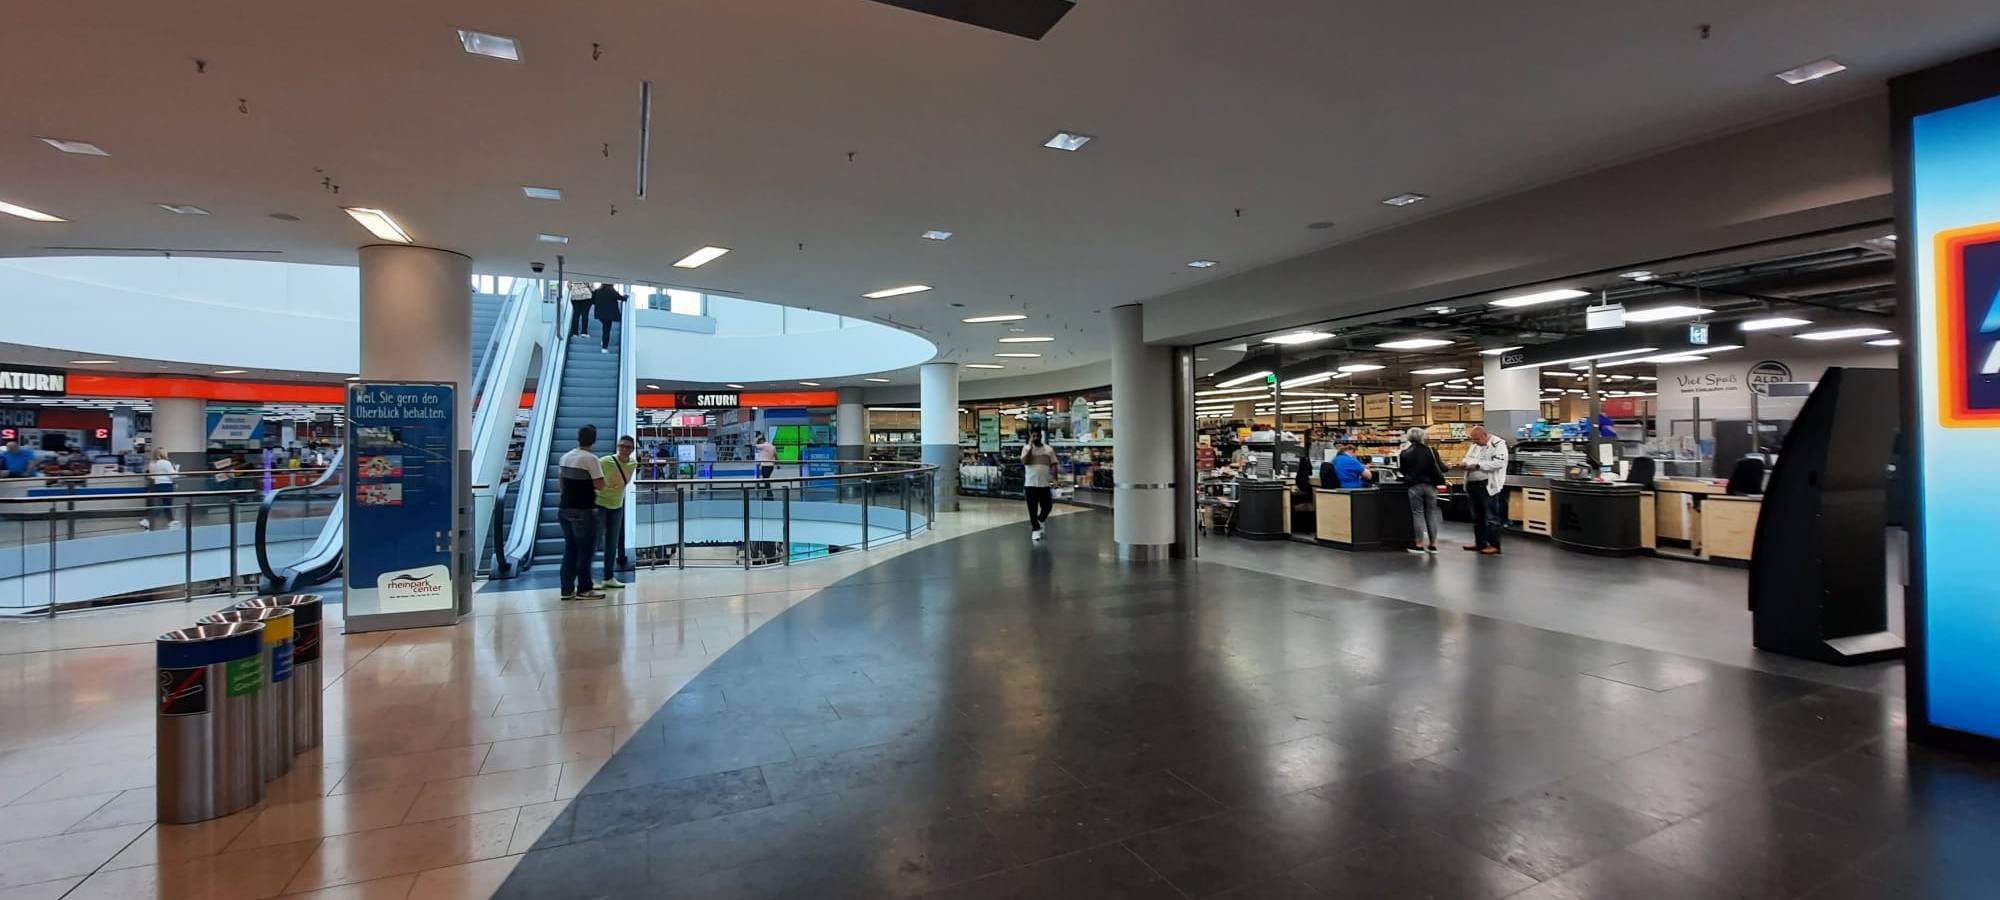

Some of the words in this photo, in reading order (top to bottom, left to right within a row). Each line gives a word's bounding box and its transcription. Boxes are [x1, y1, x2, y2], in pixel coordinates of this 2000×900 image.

[1677, 375, 1701, 387] Viel
[1754, 375, 1784, 383] ALDI
[356, 391, 376, 404] Weil
[379, 391, 394, 404] Sie
[397, 394, 418, 407] gern
[422, 392, 438, 404] den
[697, 395, 738, 406] SATURN
[404, 406, 446, 419] behalten.
[387, 579, 430, 590] rheinpark
